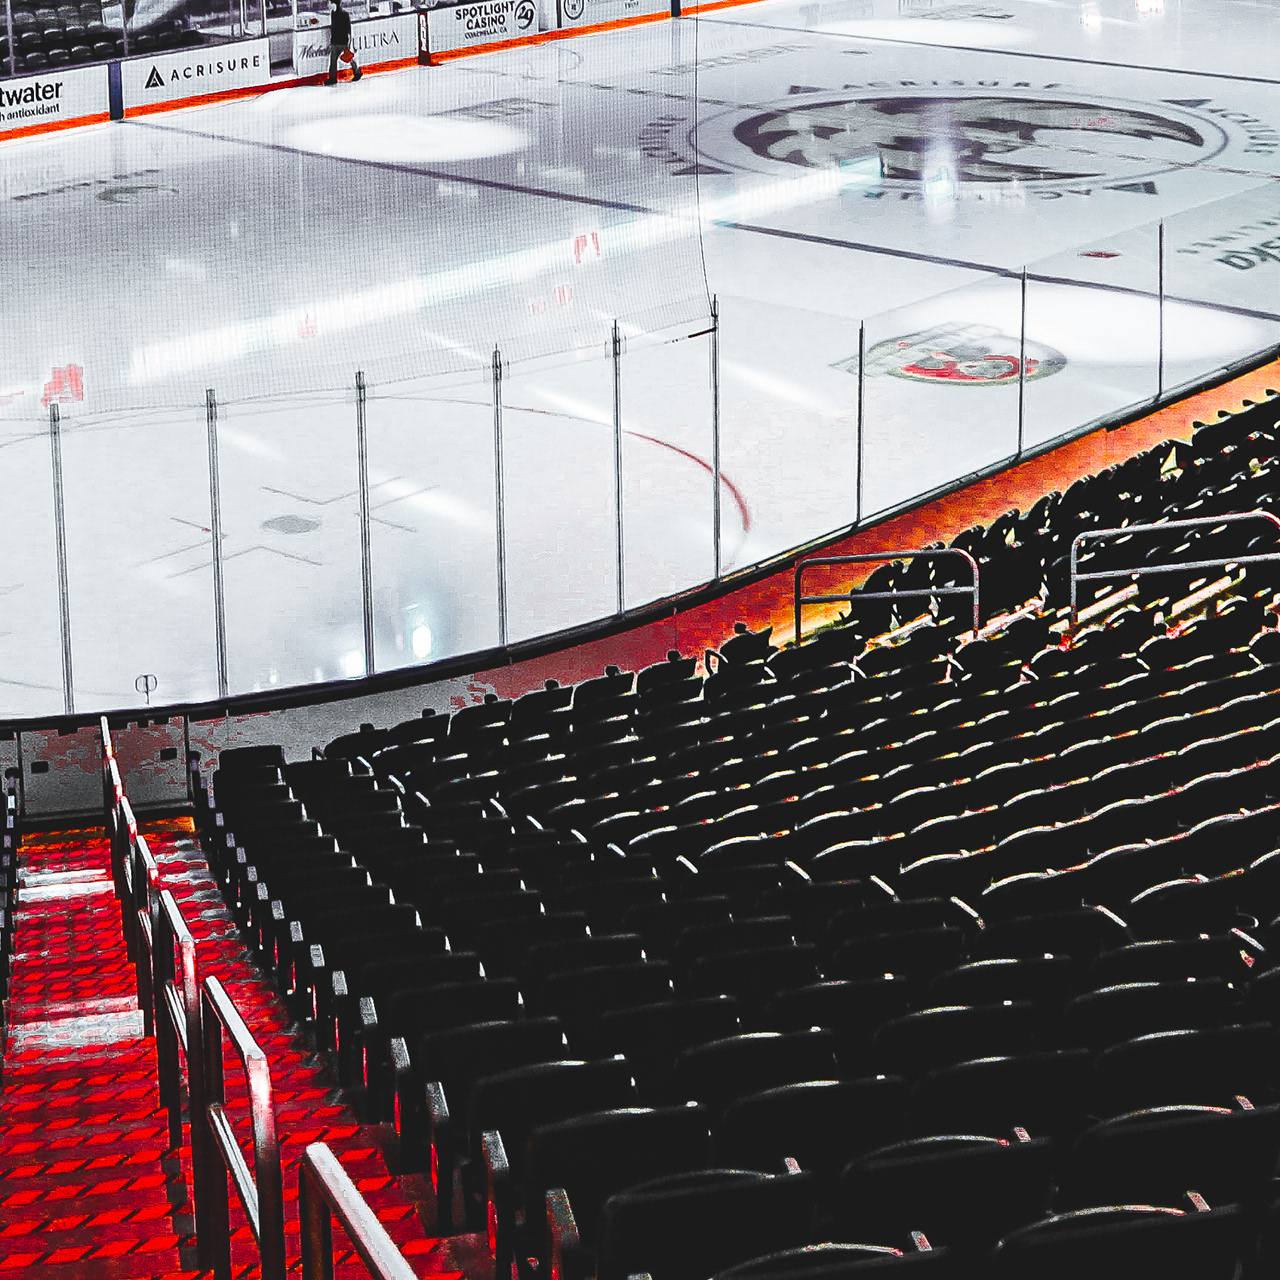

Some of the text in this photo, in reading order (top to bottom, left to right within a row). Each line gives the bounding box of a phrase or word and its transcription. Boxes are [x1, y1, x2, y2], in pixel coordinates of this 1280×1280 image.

[455, 0, 515, 20] SPOTLIGHT
[466, 16, 506, 30] CASINO
[352, 30, 400, 52] ULTRA
[170, 55, 260, 82] ACRISURE
